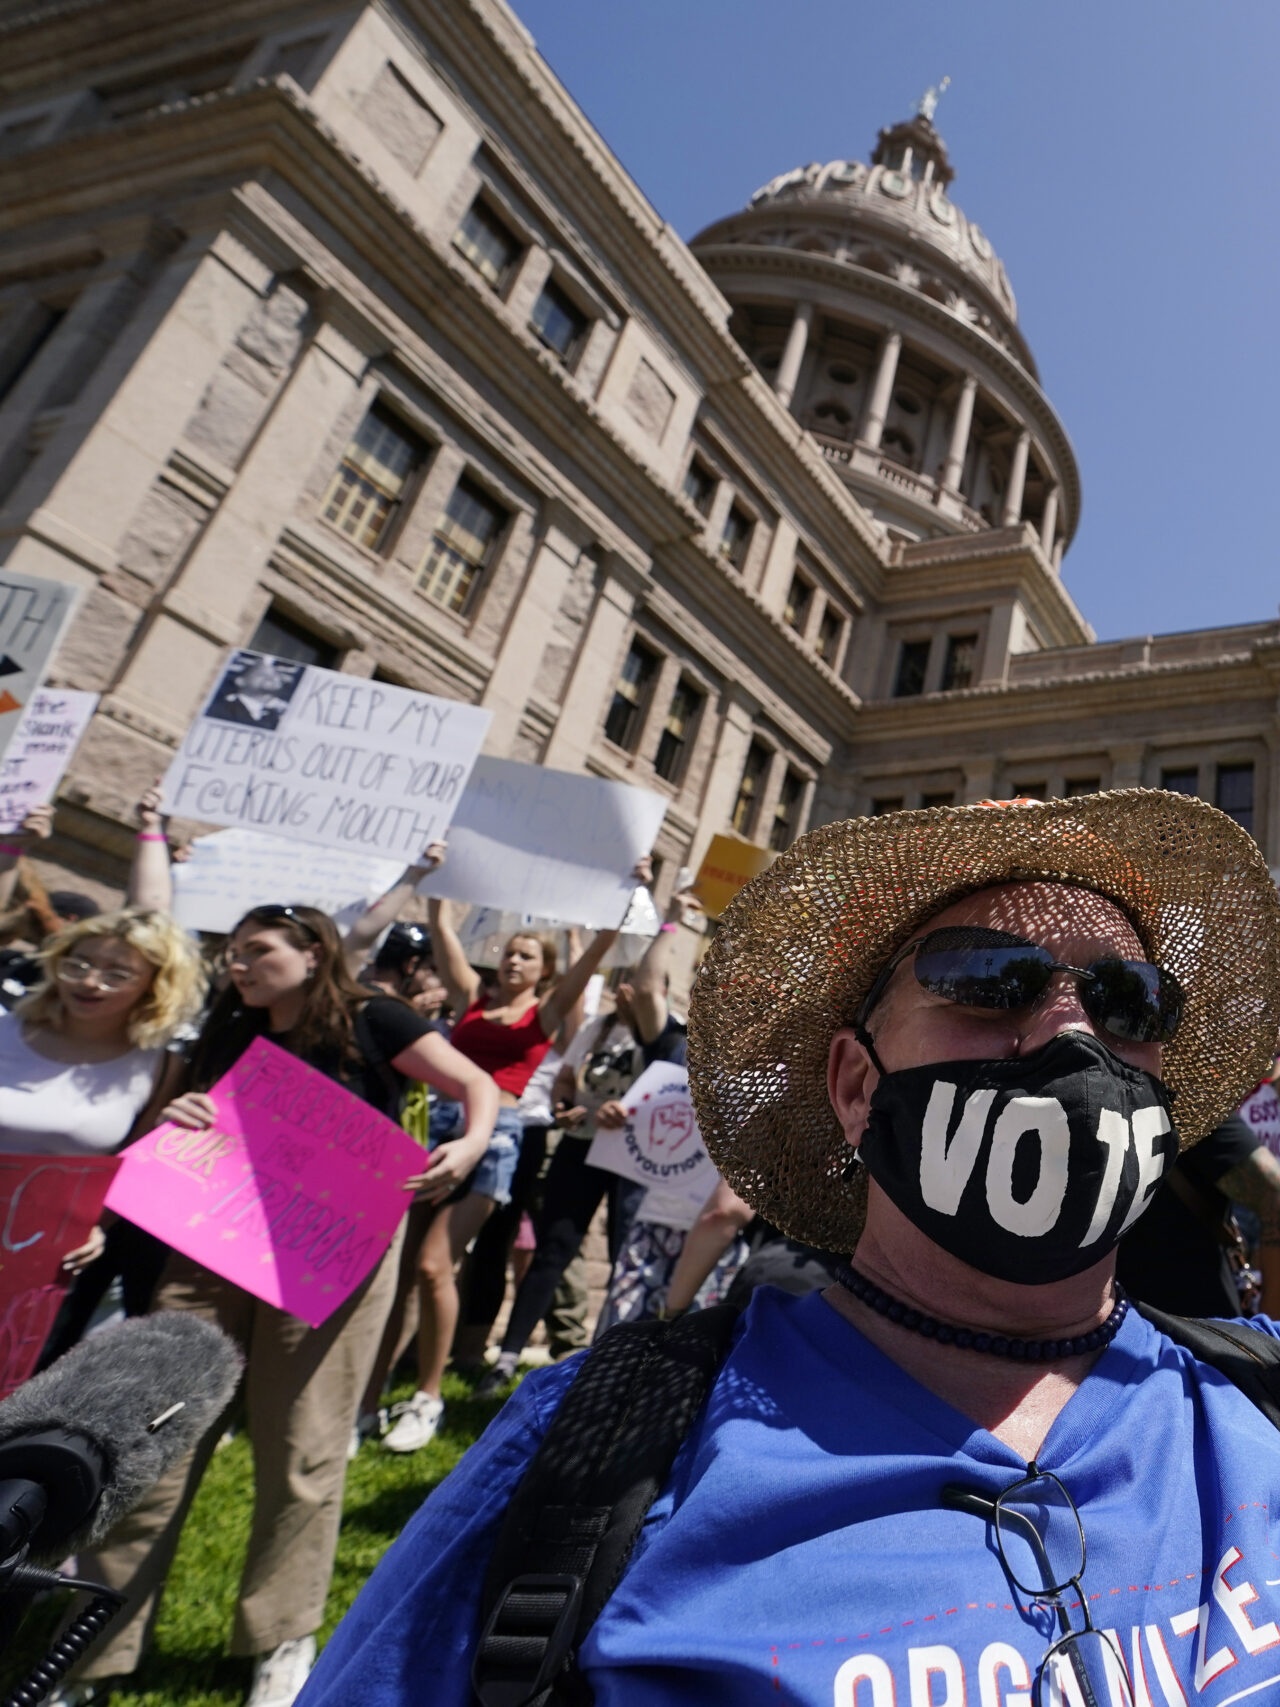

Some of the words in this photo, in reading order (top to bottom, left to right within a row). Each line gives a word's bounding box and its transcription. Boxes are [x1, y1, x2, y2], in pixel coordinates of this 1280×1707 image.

[299, 677, 387, 732] KEEP
[387, 699, 453, 747] MY
[182, 721, 301, 774] UTERUS
[302, 741, 366, 785] OUT
[358, 750, 400, 792] OF
[400, 755, 467, 804] YOUR
[317, 795, 437, 850] MOUTH
[235, 1056, 390, 1170] FREEDOM
[919, 1079, 1172, 1249] VOTE
